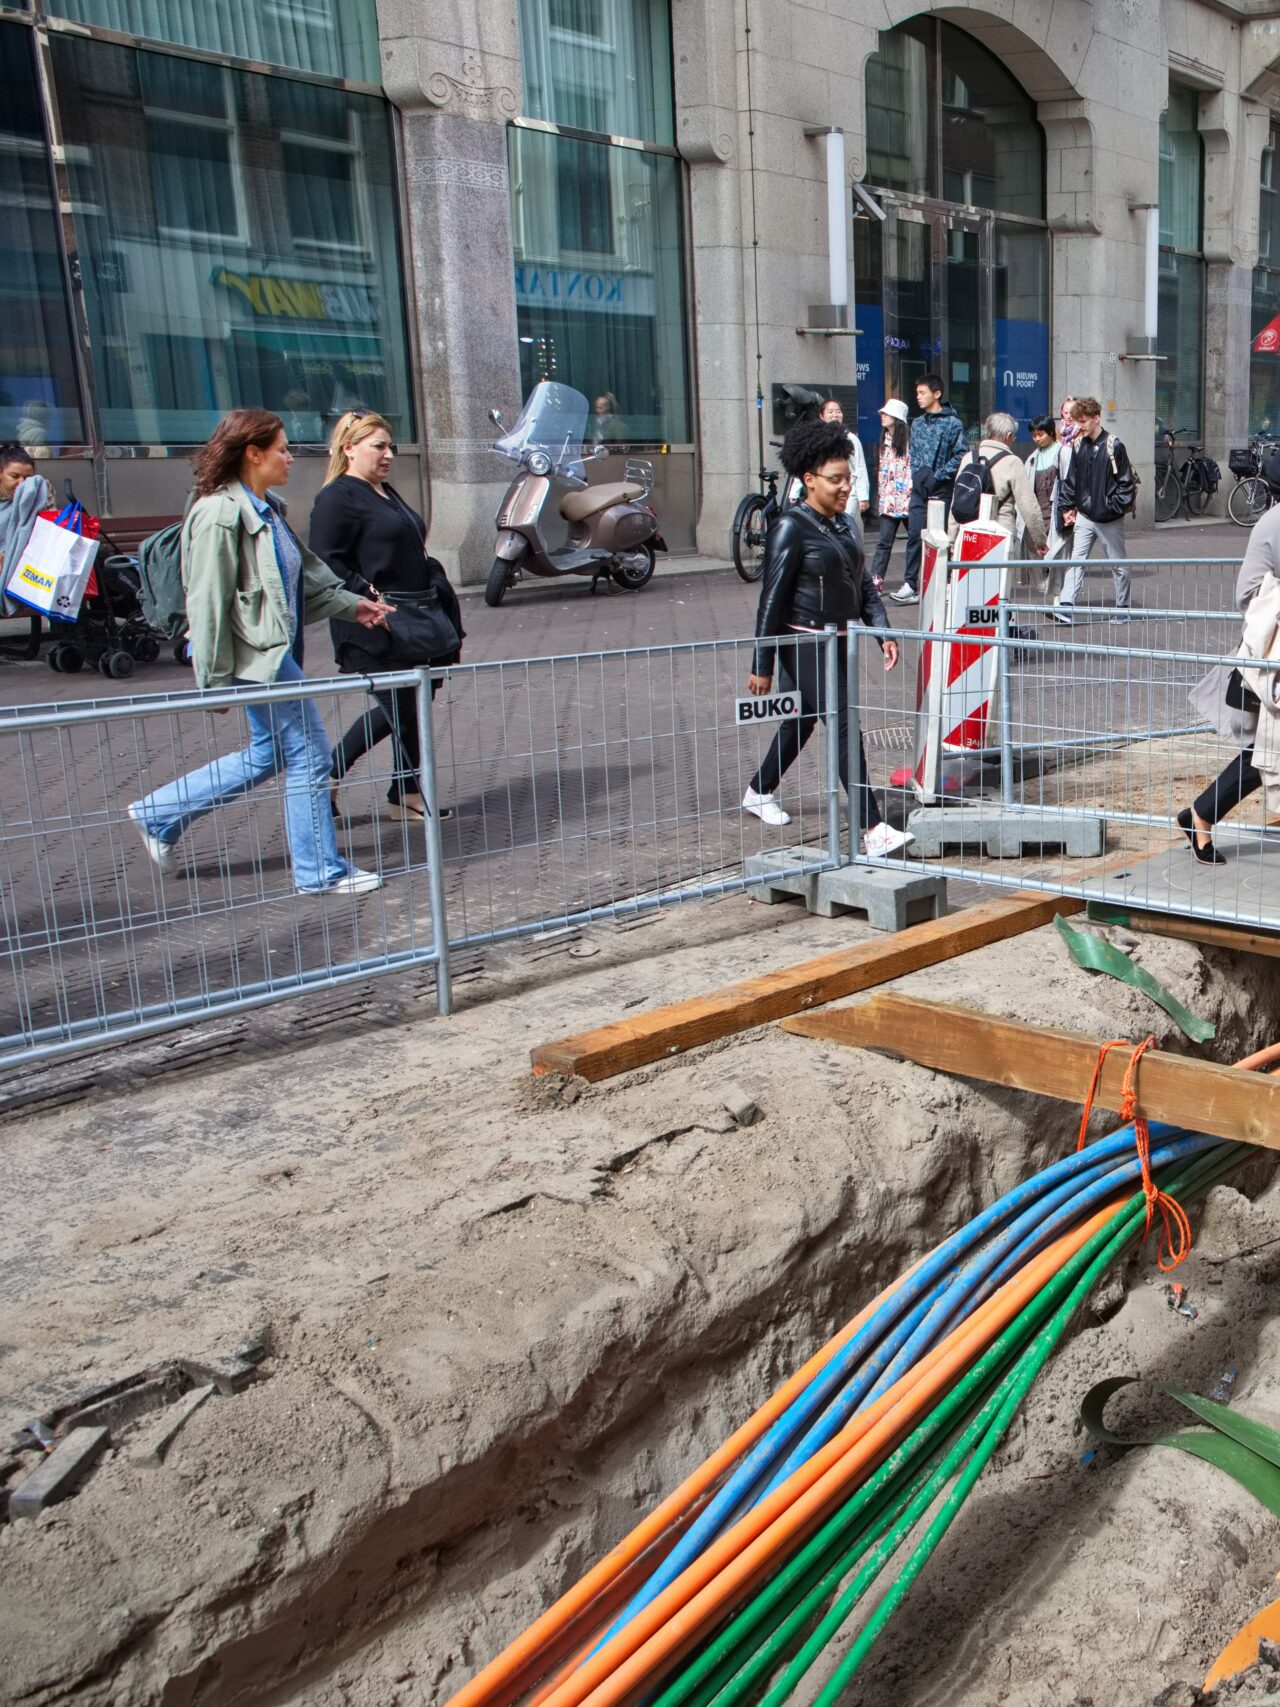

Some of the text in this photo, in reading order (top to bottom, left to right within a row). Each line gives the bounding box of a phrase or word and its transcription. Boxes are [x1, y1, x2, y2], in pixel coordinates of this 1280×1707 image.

[963, 533, 978, 543] HvE
[969, 610, 1015, 623] BUK.
[739, 696, 799, 721] BUKO.
